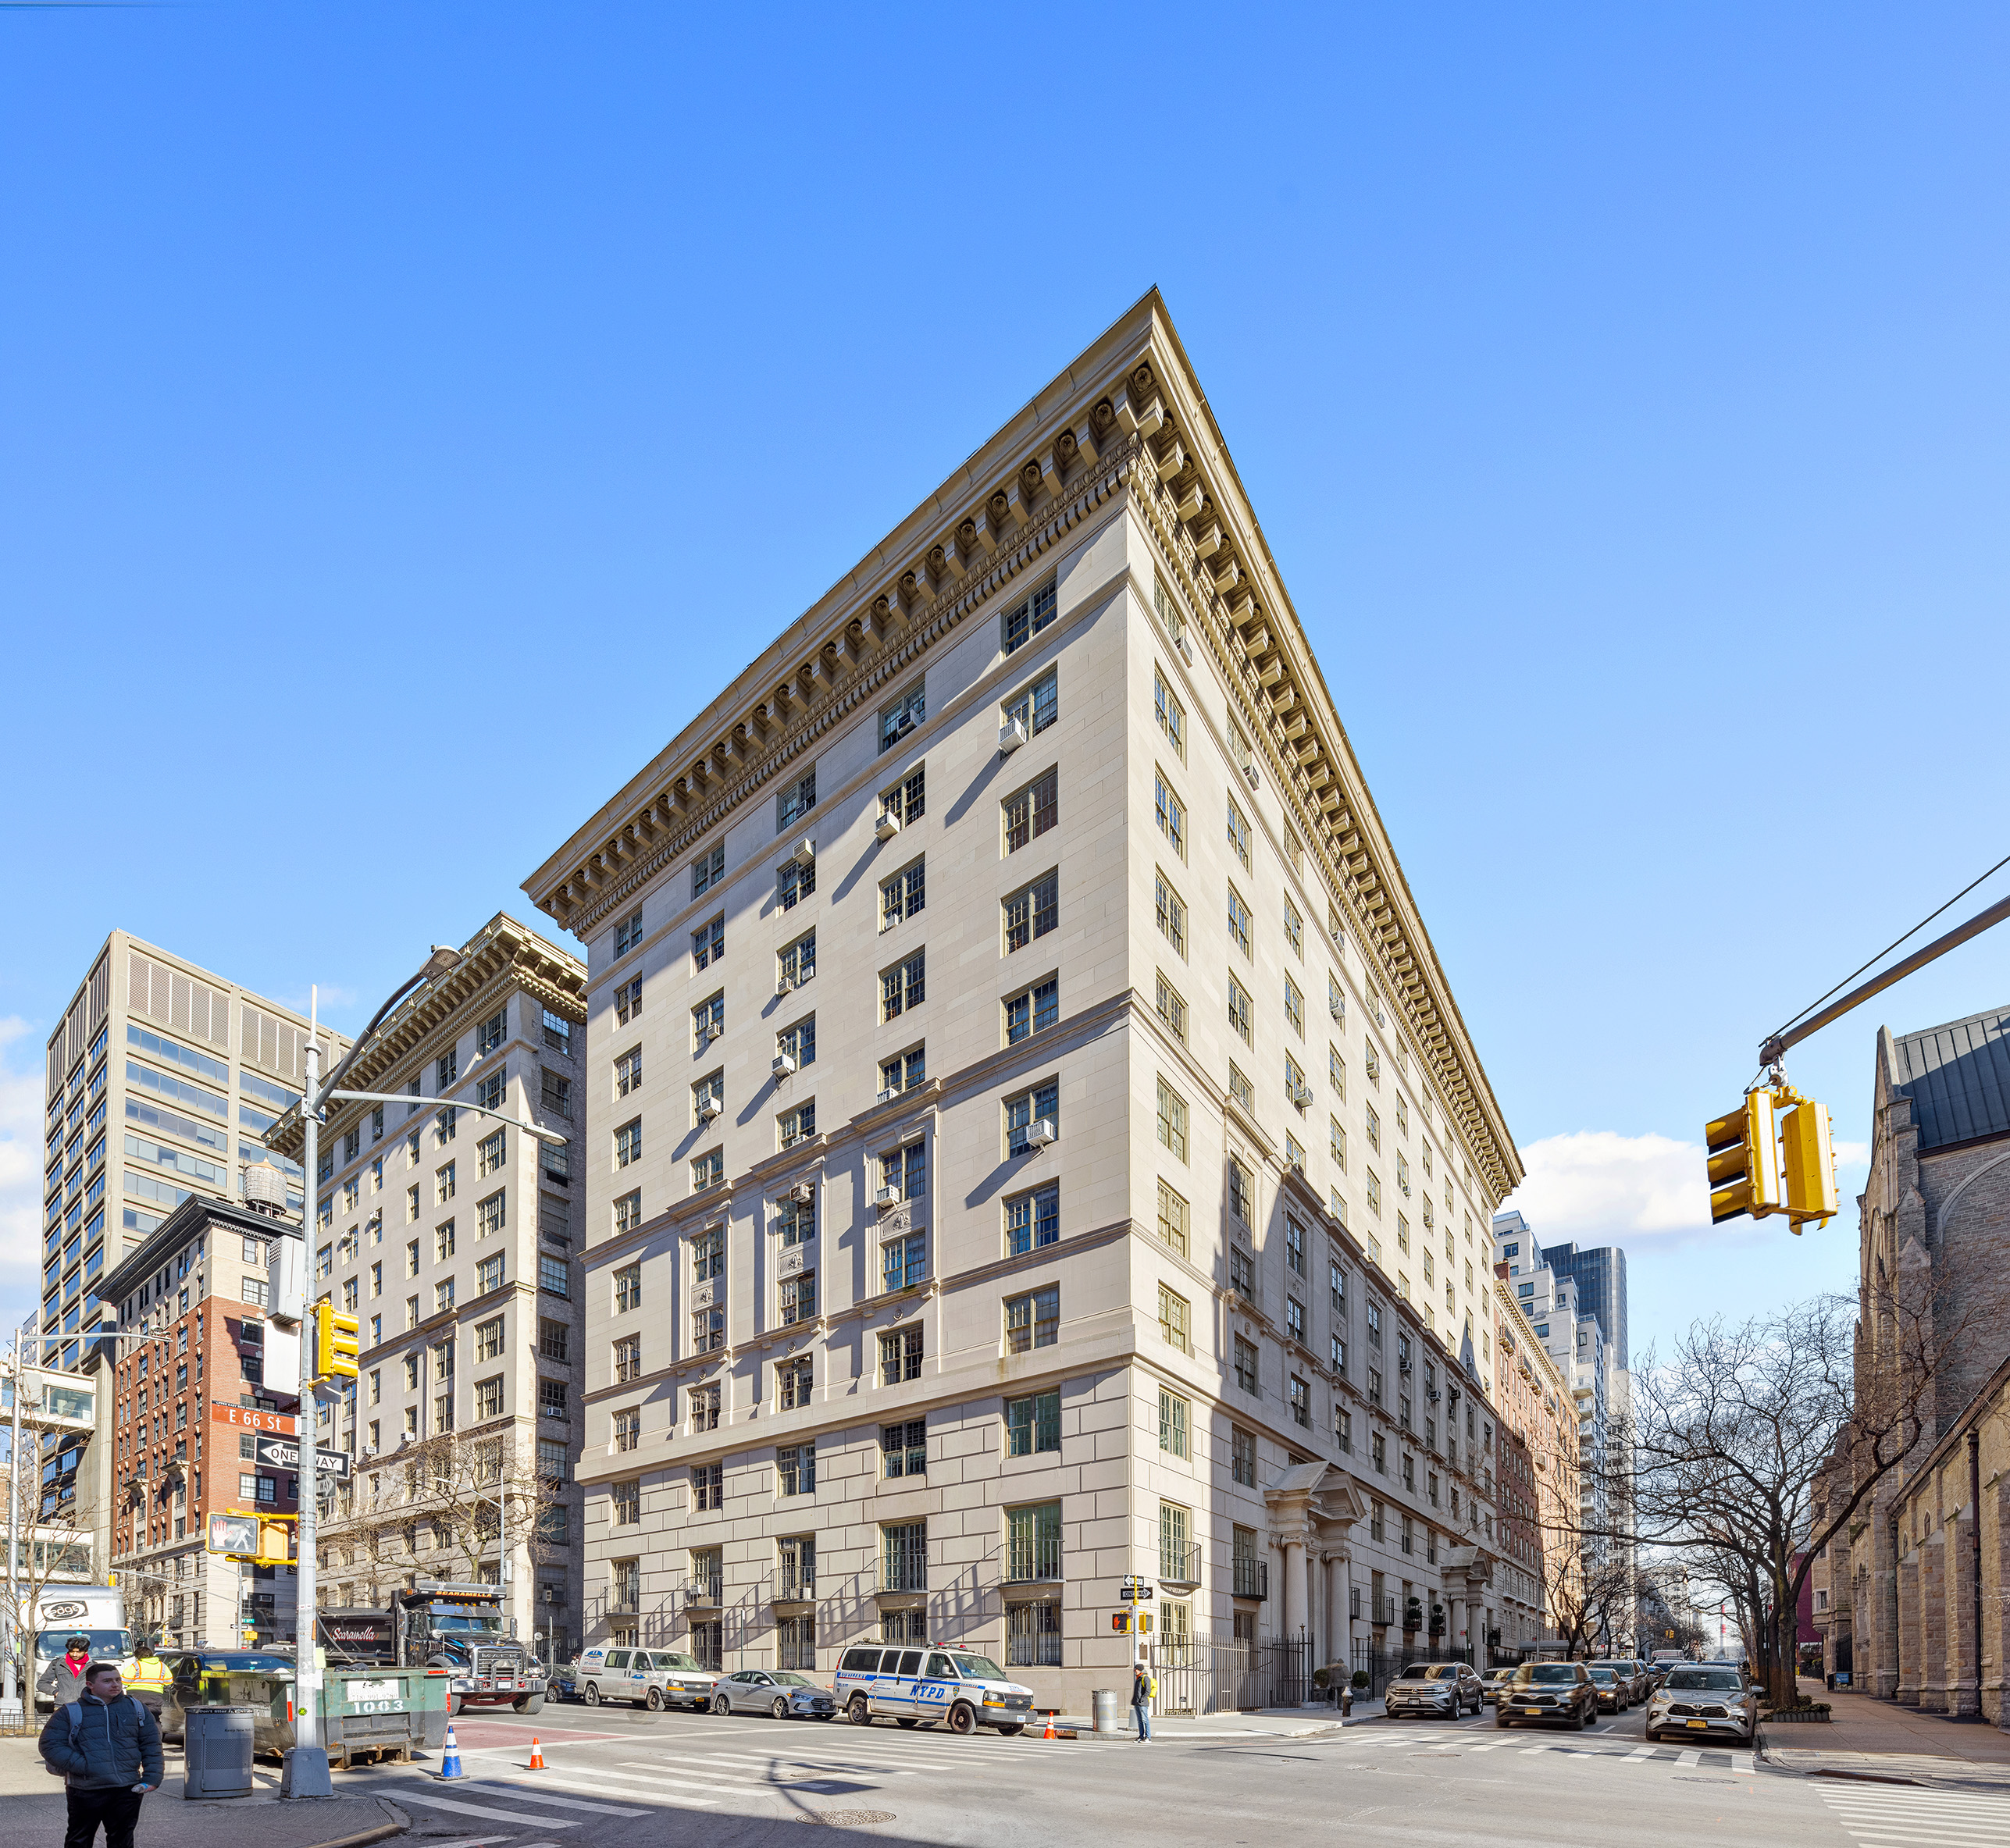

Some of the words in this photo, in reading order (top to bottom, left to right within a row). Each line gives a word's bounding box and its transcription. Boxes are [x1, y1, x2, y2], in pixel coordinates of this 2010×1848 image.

[229, 1408, 237, 1423] E
[243, 1412, 261, 1427] 66
[267, 1416, 281, 1431] St
[271, 1448, 298, 1462] ONE
[50, 1605, 79, 1617] edge
[332, 1625, 376, 1641] Scaramella
[910, 1685, 945, 1699] NYPD
[354, 1700, 404, 1714] 1003
